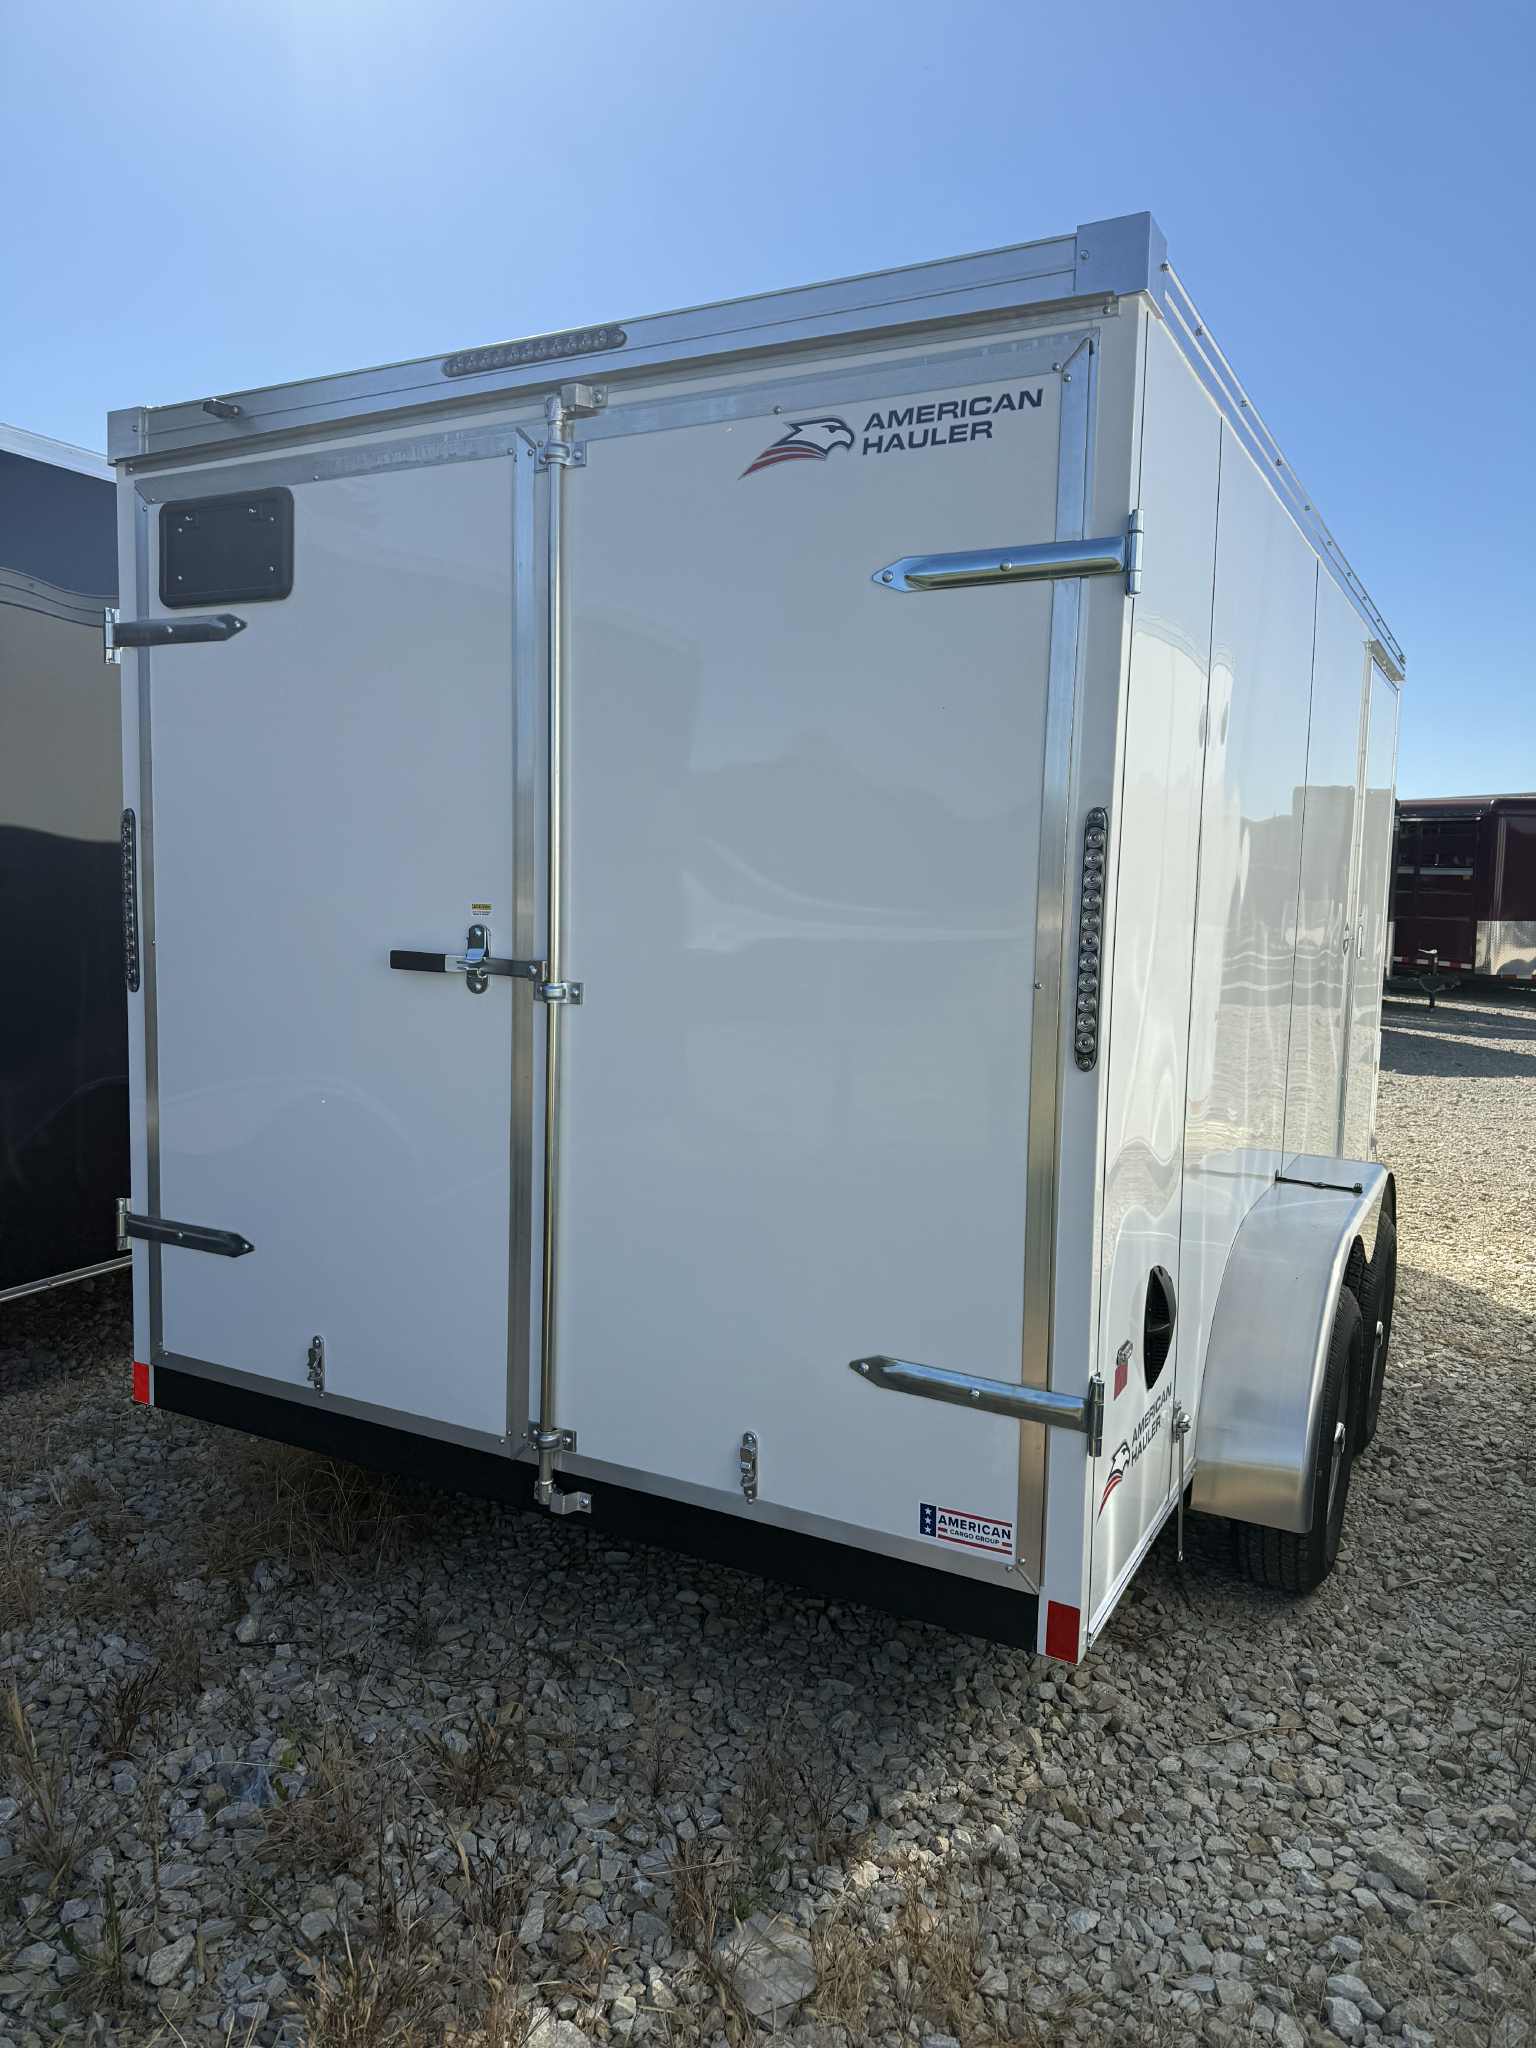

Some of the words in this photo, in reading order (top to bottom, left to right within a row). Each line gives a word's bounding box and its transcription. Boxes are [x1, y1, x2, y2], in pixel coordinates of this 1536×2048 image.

[863, 388, 1044, 432] AMERICAN
[862, 420, 993, 456] HAULER
[1131, 1381, 1172, 1447] AMERICAN
[1131, 1414, 1161, 1467] HAULER
[938, 1514, 1011, 1540] AMERICAN
[949, 1528, 974, 1540] CARGO
[975, 1535, 1000, 1545] GROUP
